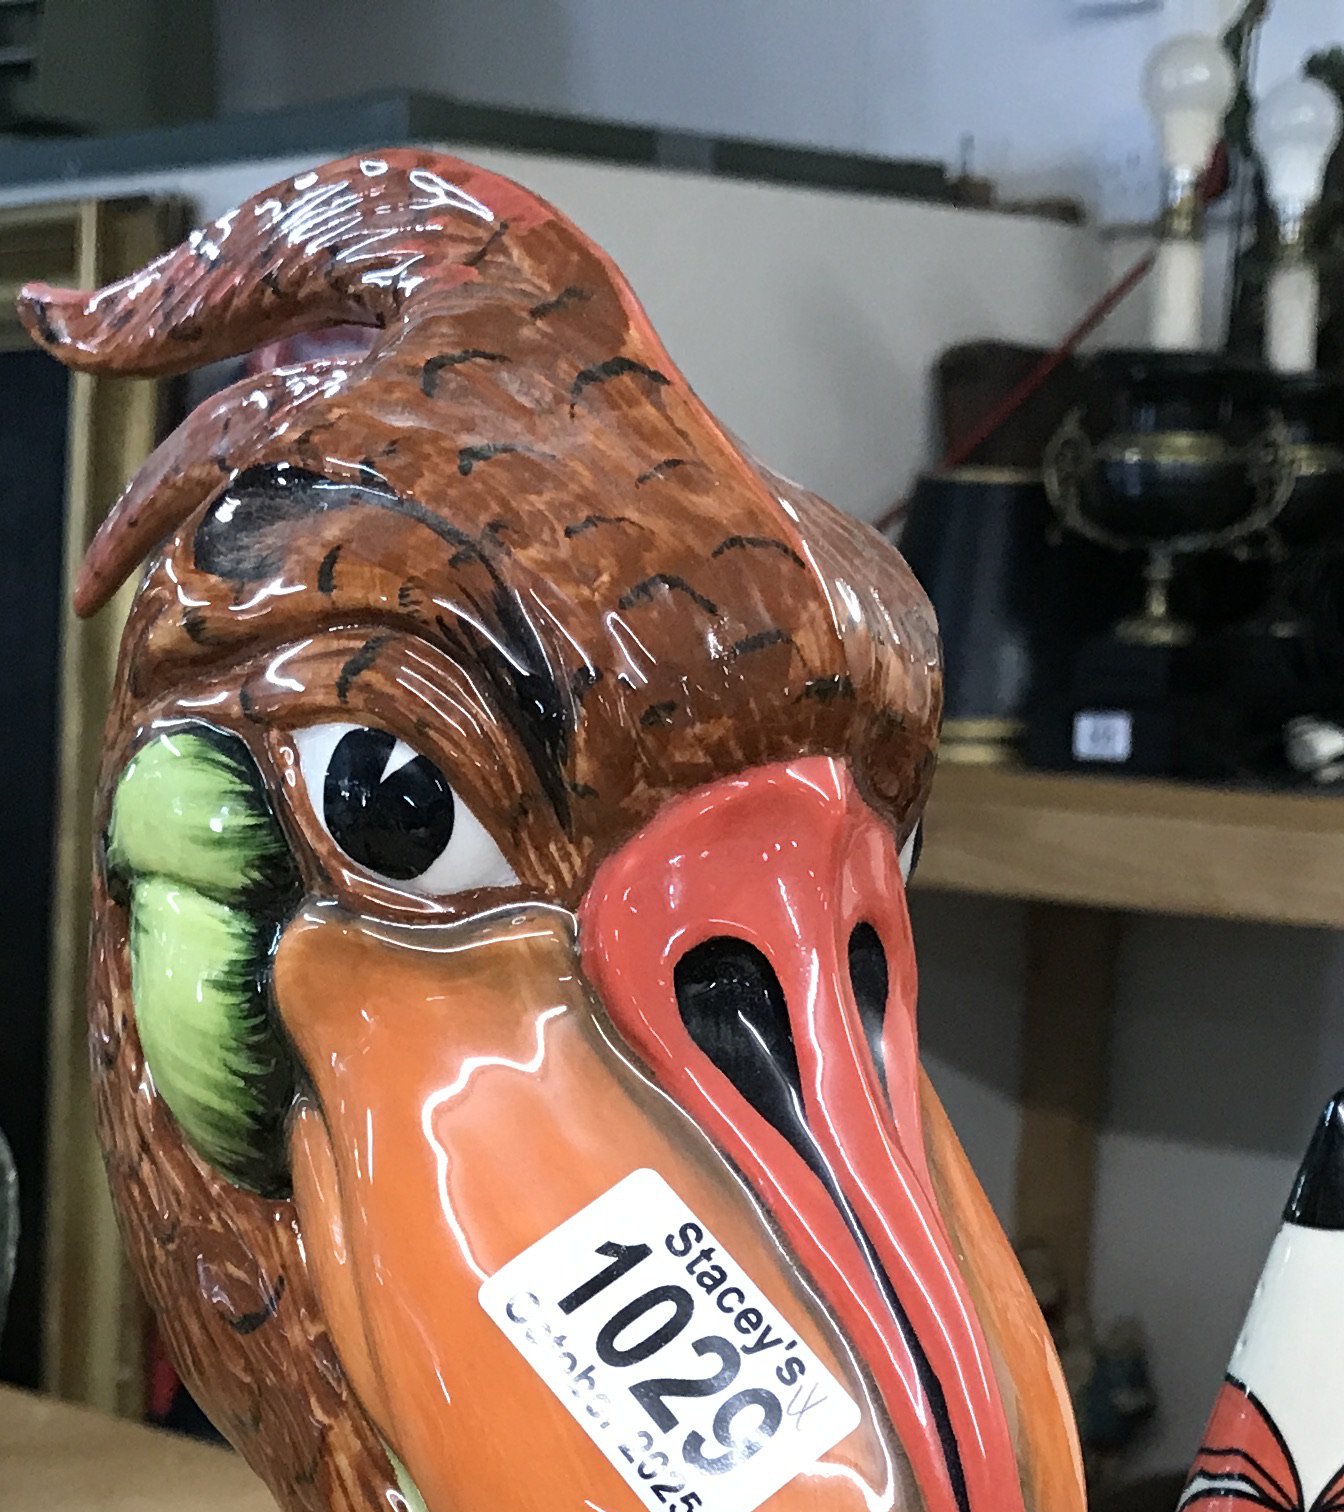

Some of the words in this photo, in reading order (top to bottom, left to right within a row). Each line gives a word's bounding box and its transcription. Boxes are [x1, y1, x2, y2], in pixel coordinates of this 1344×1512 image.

[505, 1291, 611, 1429] Otob
[557, 1240, 783, 1476] 1029
[665, 1221, 807, 1387] Stacey's
